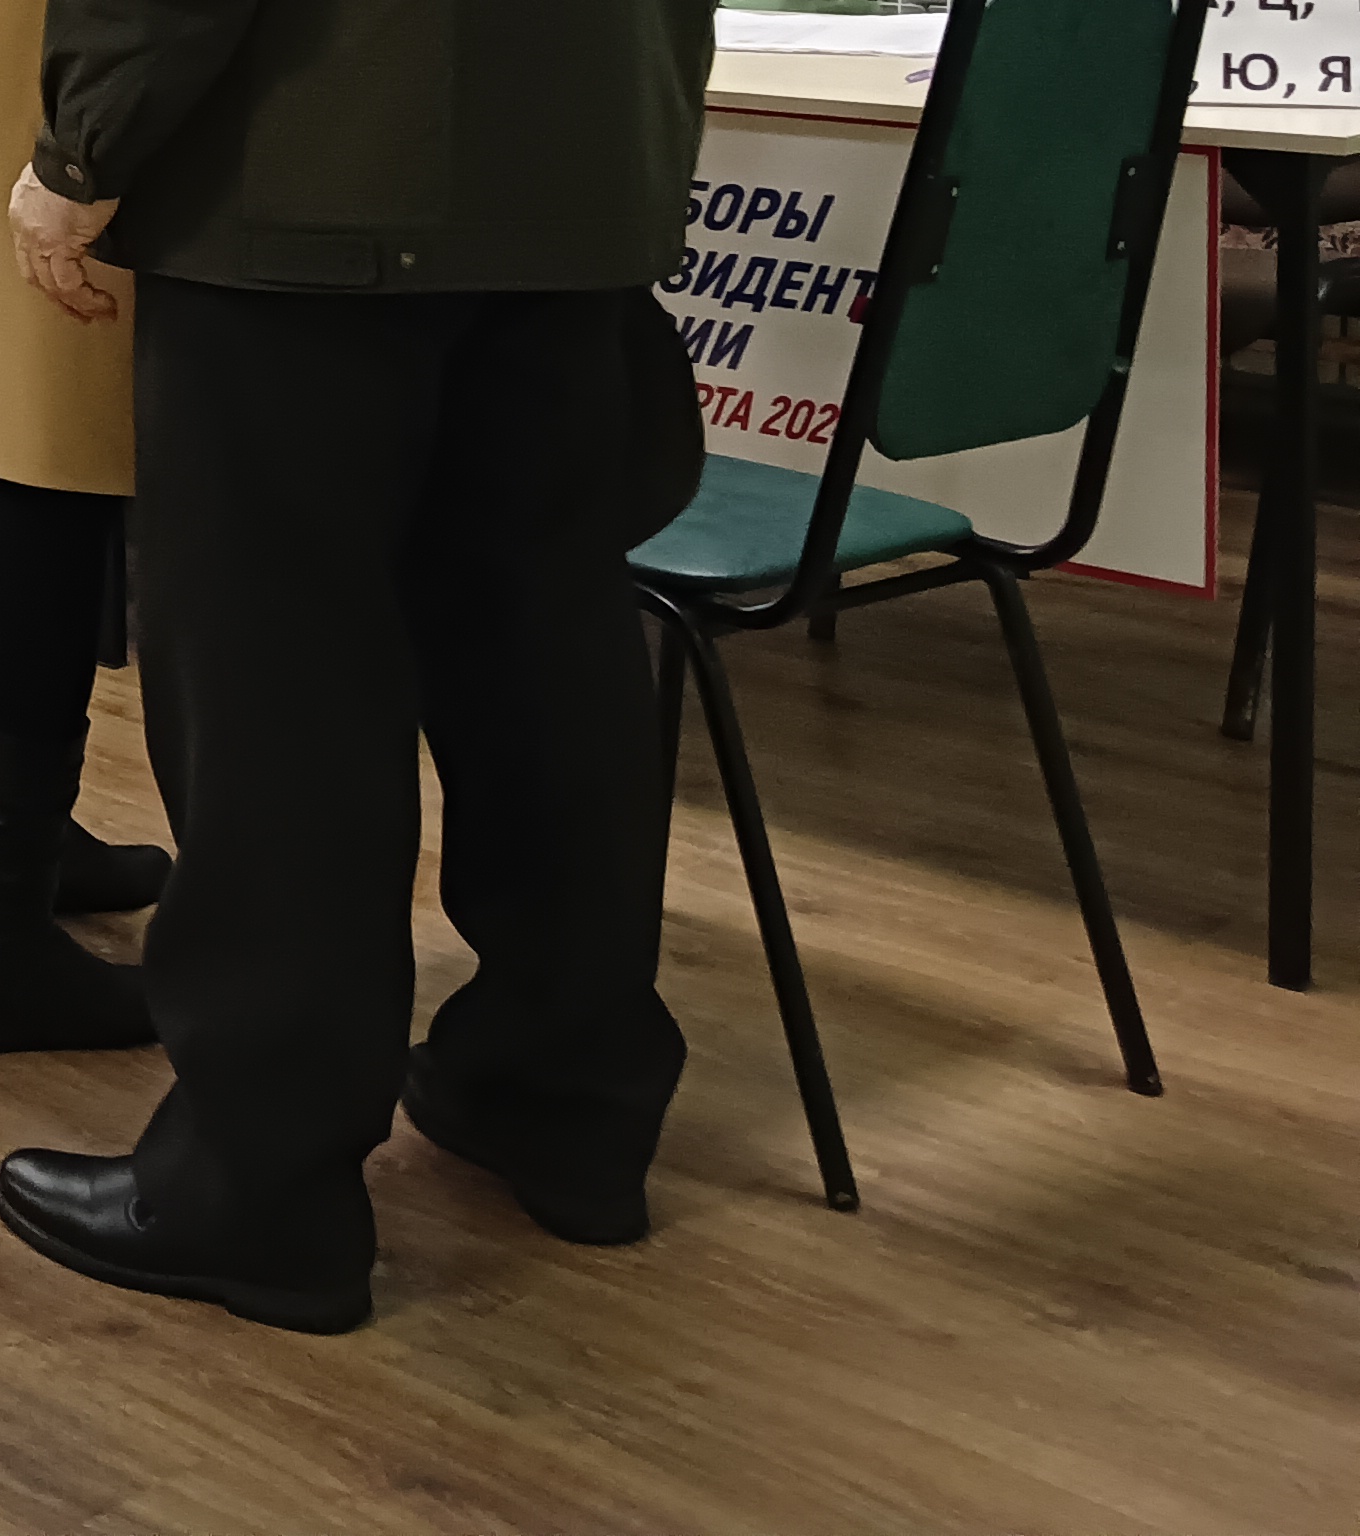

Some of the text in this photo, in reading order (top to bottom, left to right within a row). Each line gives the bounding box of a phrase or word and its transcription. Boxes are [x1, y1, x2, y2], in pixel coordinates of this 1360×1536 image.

[1223, 53, 1352, 98] Ю, Я
[685, 180, 835, 243] БОРЫ
[659, 247, 879, 315] ЗИДЕНТ
[696, 382, 841, 444] РТА 202
